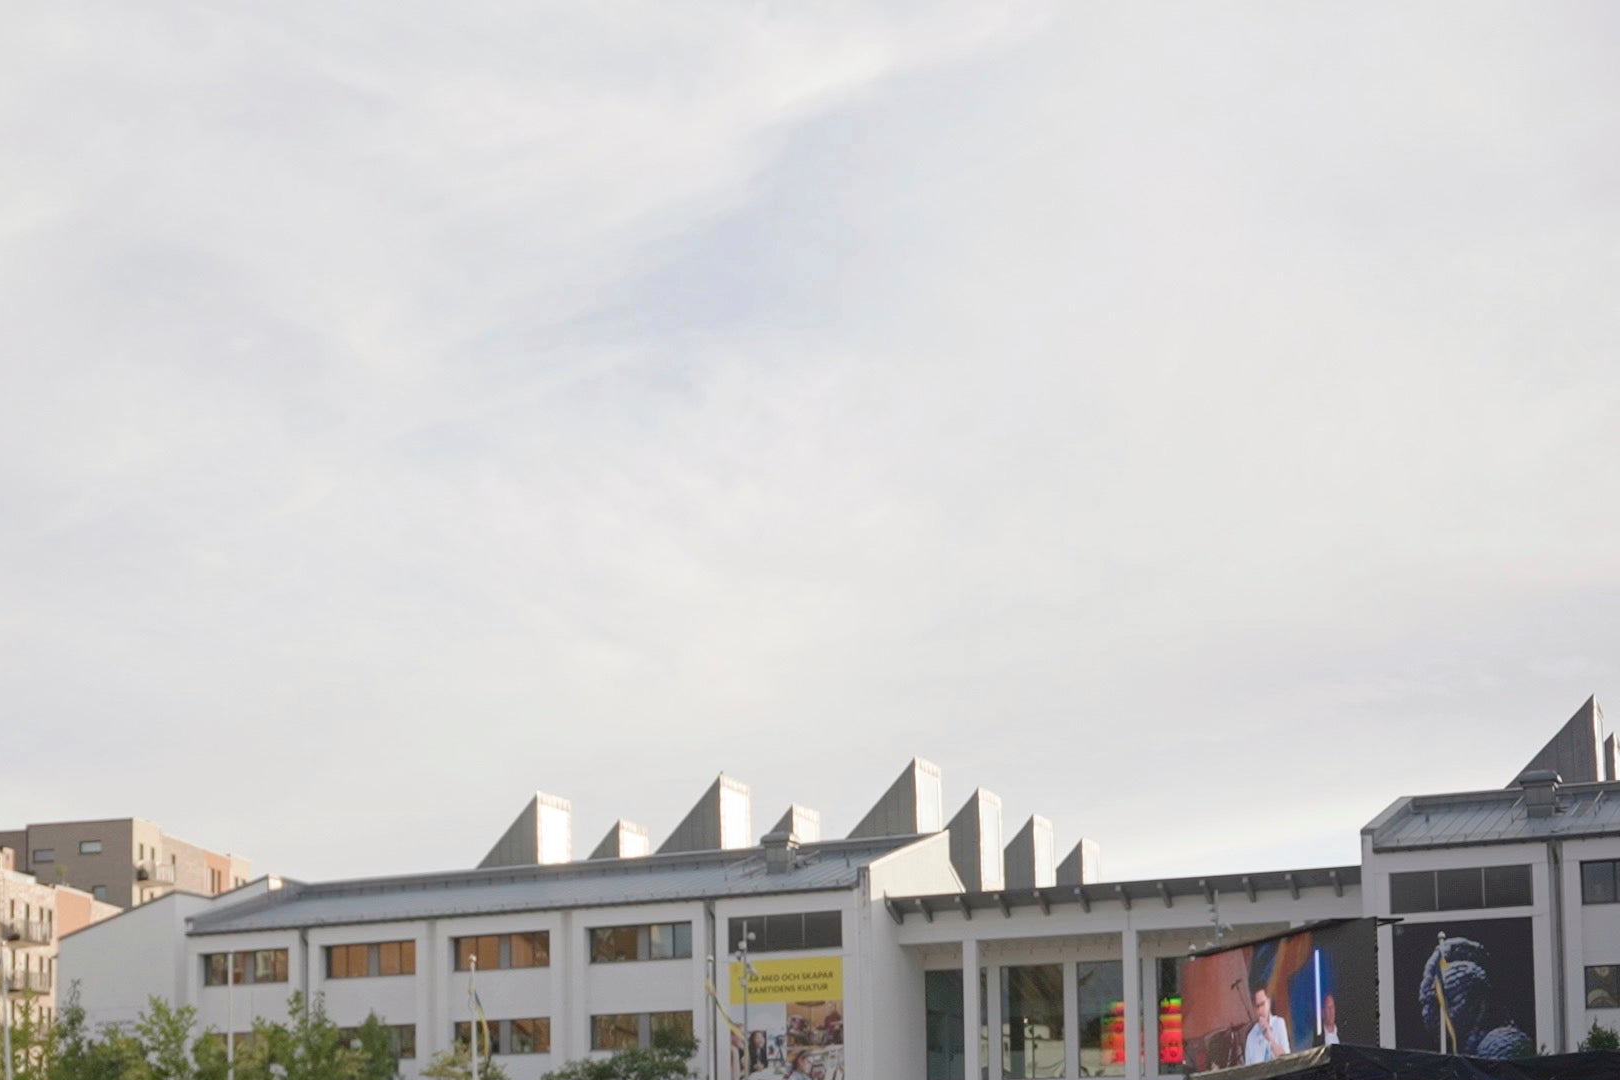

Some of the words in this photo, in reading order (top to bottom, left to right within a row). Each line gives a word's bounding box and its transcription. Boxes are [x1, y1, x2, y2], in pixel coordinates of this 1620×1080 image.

[761, 973, 780, 982] MED
[781, 973, 800, 981] OCH
[802, 971, 834, 980] SKAPAR
[745, 984, 795, 993] RAMTIDENS
[797, 983, 829, 992] KULTUR
